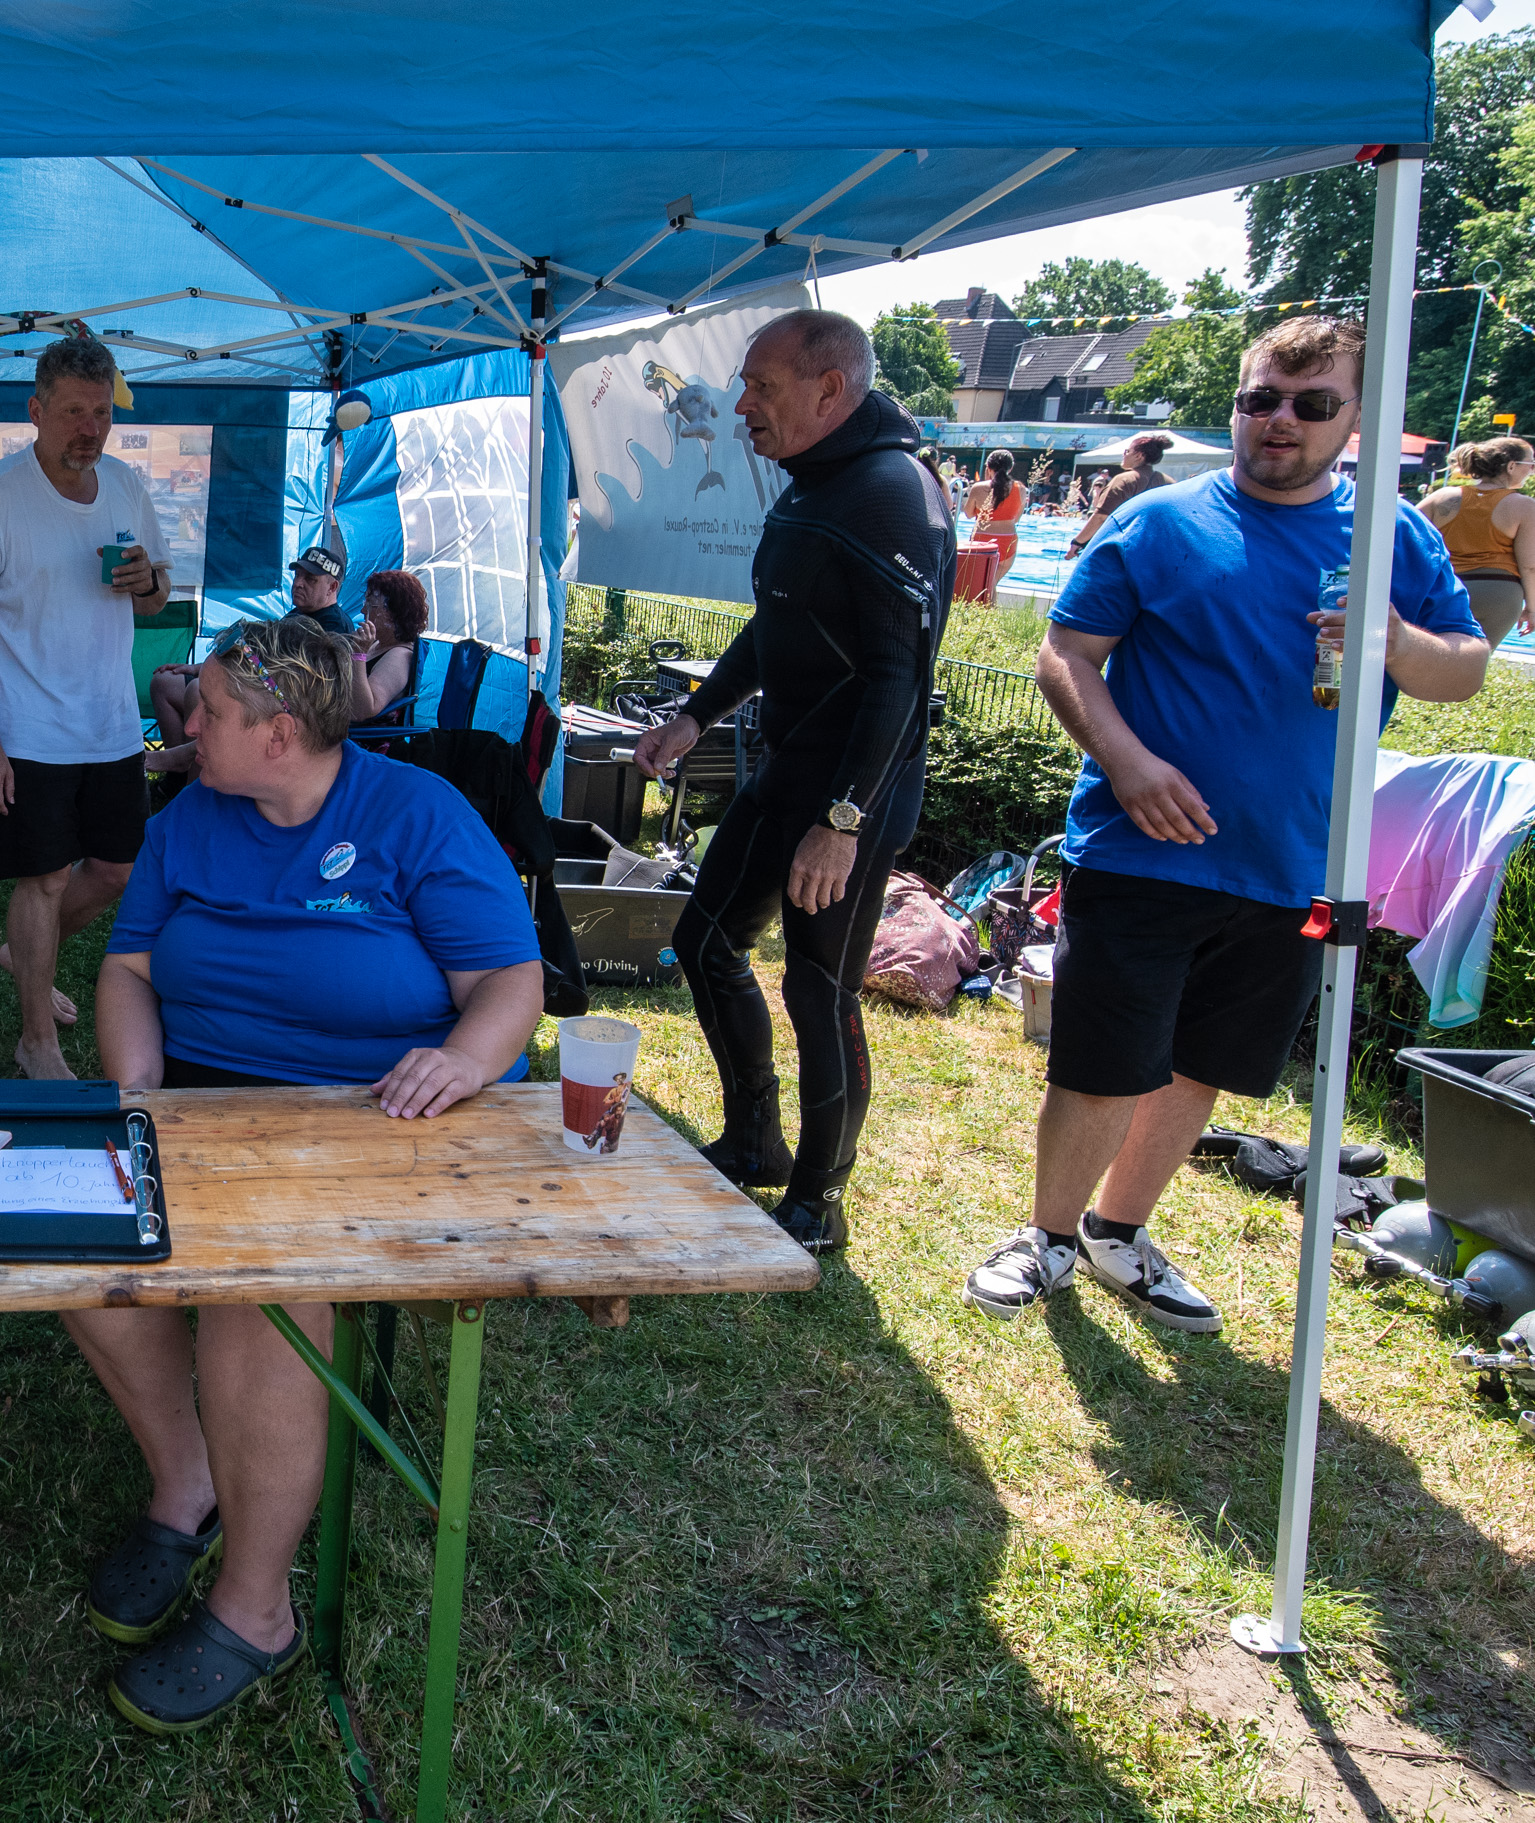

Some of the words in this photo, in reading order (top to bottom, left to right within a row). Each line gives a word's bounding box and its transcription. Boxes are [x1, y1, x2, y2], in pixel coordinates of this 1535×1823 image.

[307, 550, 341, 577] CEBU
[593, 958, 639, 976] Diving
[5, 1171, 34, 1182] ab
[40, 1172, 79, 1188] 10
